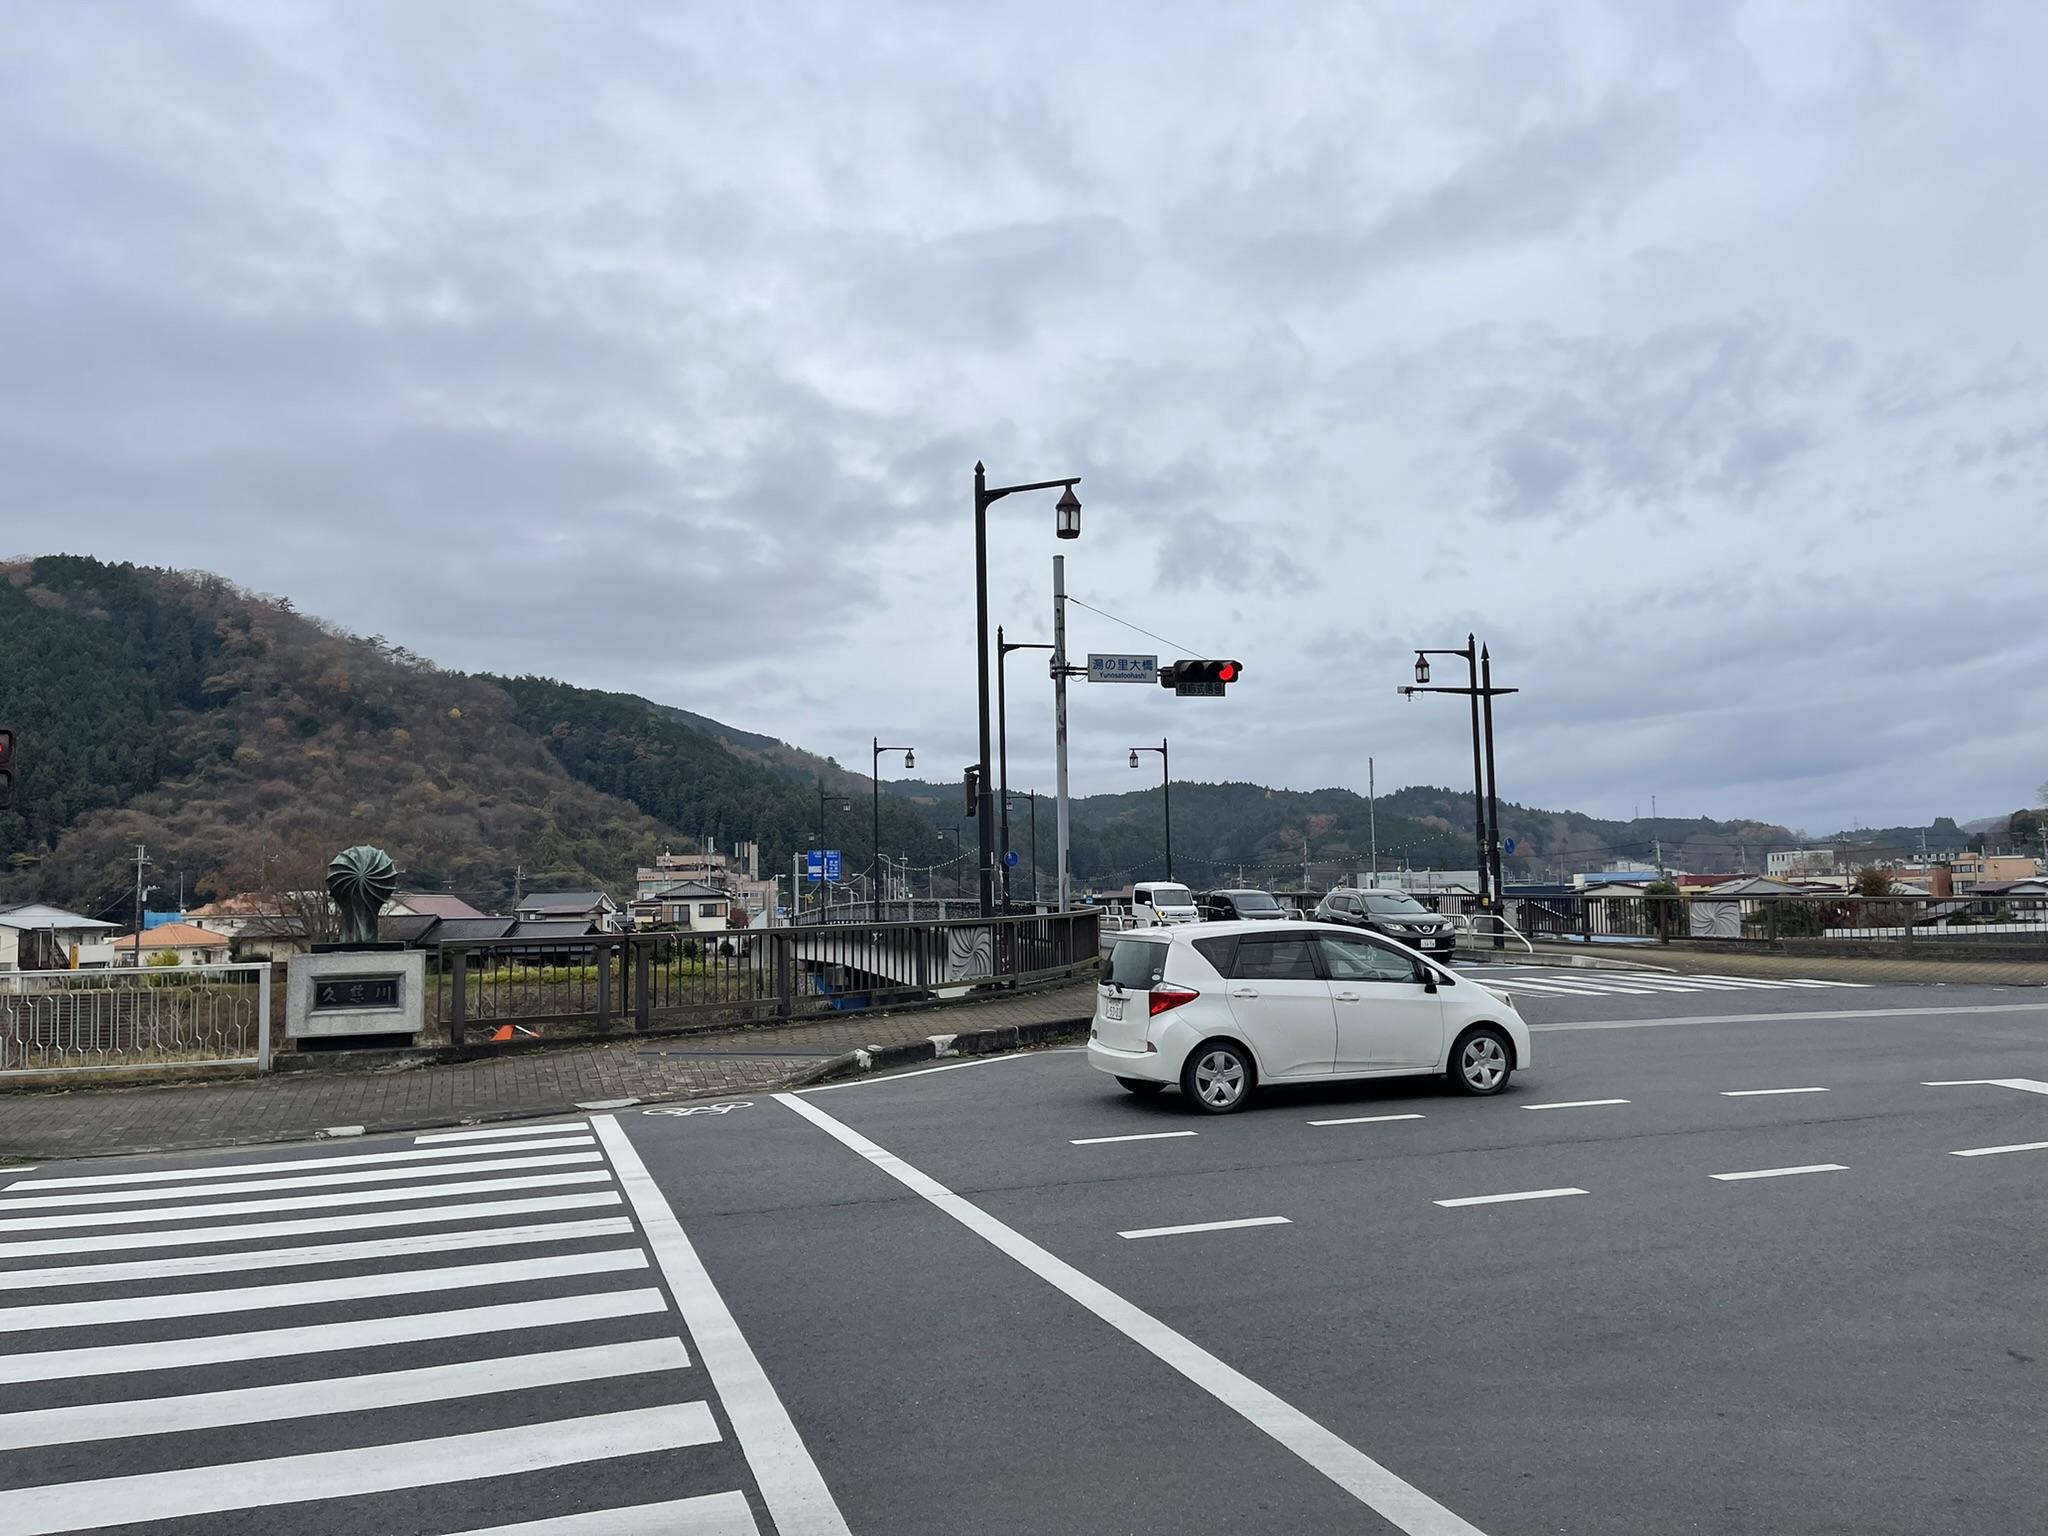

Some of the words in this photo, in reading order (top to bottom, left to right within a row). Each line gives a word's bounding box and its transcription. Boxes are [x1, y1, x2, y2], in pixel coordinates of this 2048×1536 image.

[1092, 658, 1153, 671] 湯の里大橋
[1099, 671, 1147, 679] Yunosatoohashi
[322, 984, 392, 1003] 久慈川
